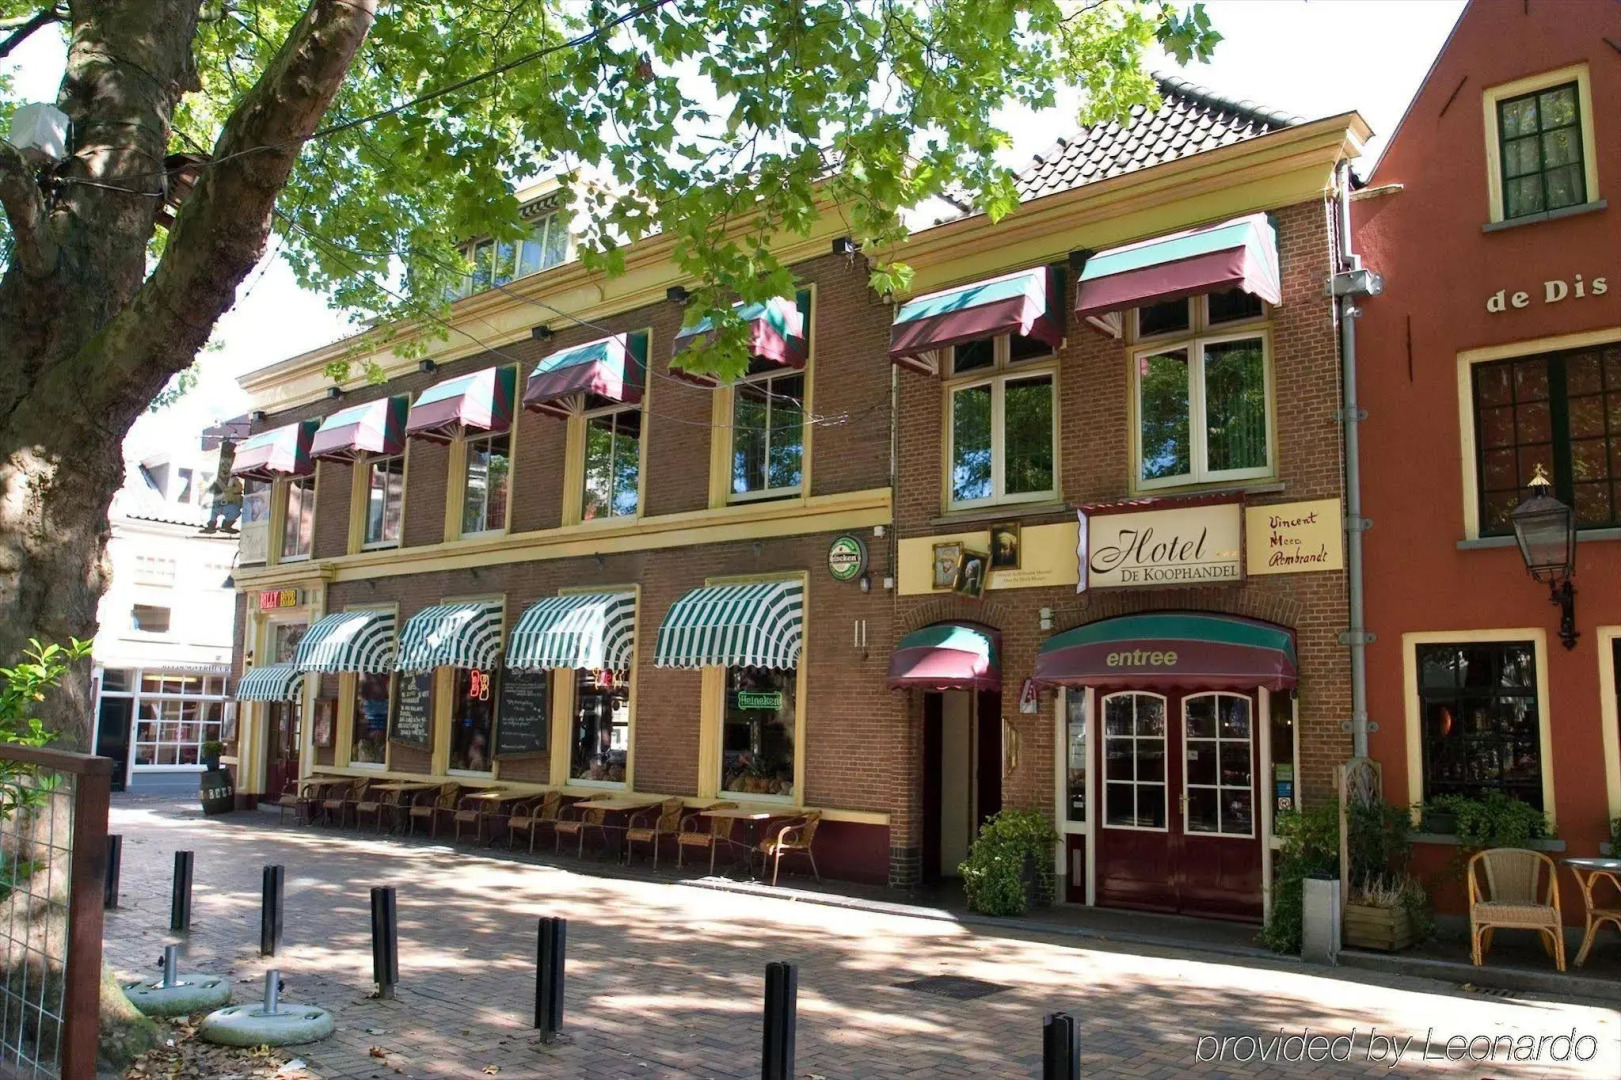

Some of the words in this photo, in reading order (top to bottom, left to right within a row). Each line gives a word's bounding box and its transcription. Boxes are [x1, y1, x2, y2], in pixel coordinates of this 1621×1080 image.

[1486, 289, 1530, 313] de
[1544, 273, 1608, 303] Dis
[1269, 511, 1318, 529] Vincent
[1090, 526, 1208, 574] Hotel
[1268, 543, 1328, 567] Rembrandt
[1143, 564, 1239, 582] KOOPHANDEL
[260, 591, 279, 609] BILLY
[1106, 648, 1178, 667] entree
[741, 695, 780, 706] Heineken
